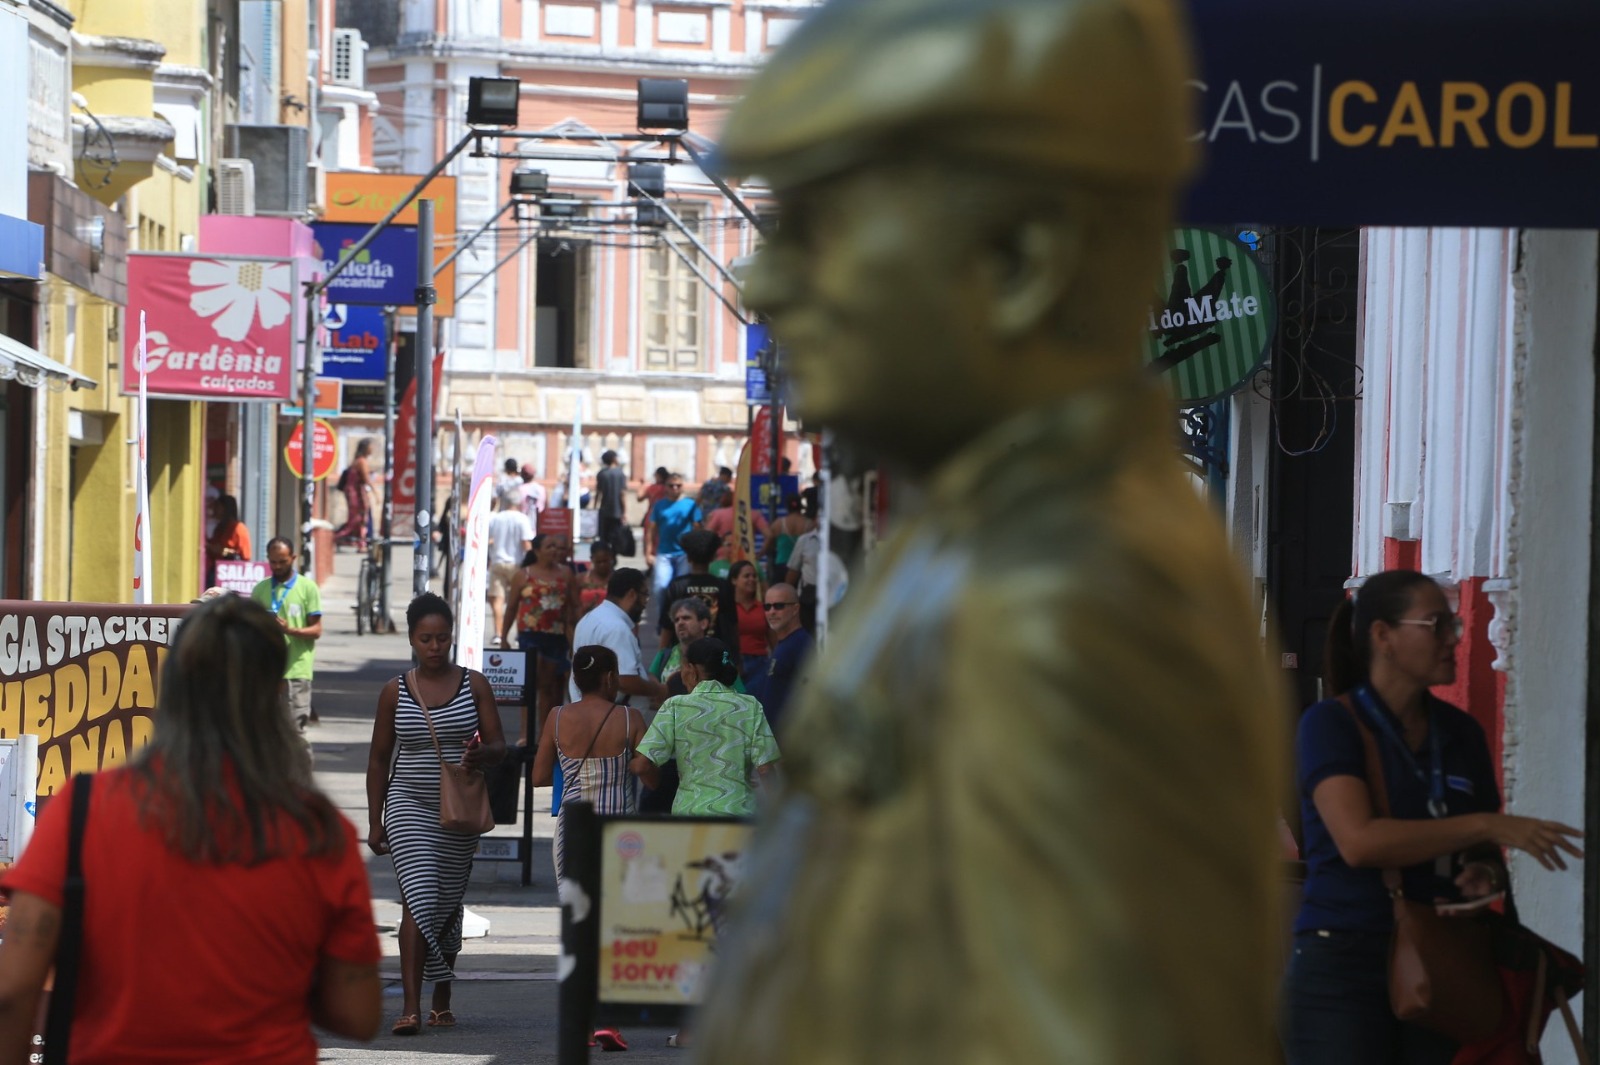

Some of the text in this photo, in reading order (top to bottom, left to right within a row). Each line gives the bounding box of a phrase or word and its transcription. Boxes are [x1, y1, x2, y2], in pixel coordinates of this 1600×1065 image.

[1328, 80, 1599, 148] CAROL
[1161, 309, 1184, 329] do
[1184, 291, 1258, 325] Mate
[132, 330, 282, 375] Gardênia
[200, 374, 275, 392] calçados
[217, 562, 266, 581] SALÃO
[0, 643, 169, 746] HEDDA
[37, 715, 155, 797] ANAD
[611, 939, 658, 959] seu
